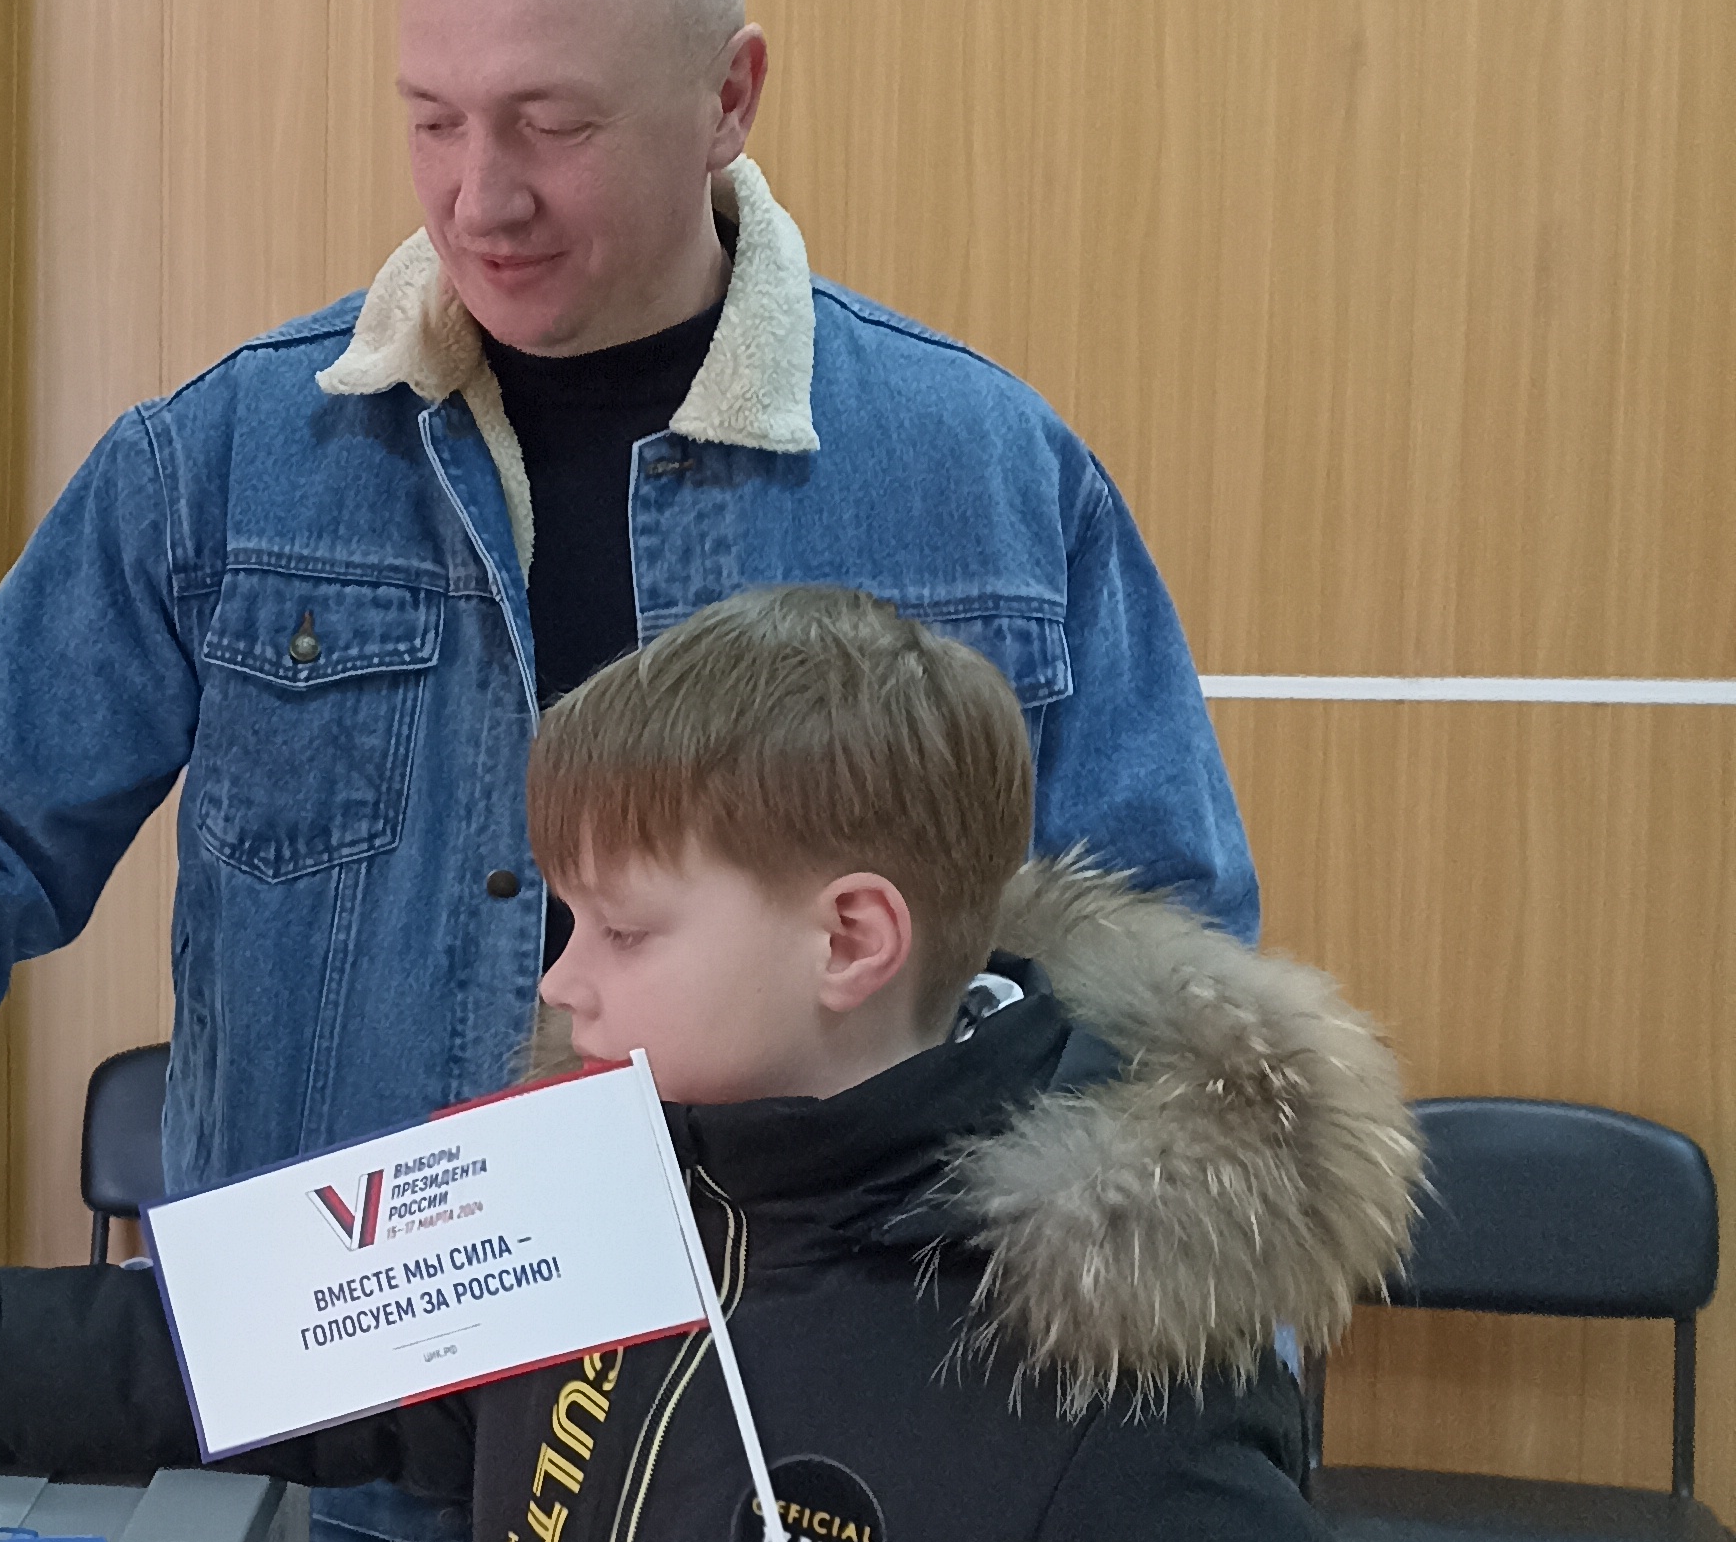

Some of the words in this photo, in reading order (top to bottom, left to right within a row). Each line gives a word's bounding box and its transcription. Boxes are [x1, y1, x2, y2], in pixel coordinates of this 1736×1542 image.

[391, 1158, 488, 1200] ПРЕЗИДЕНТА
[393, 1145, 461, 1179] ВЫБОРЫ
[388, 1190, 449, 1222] РОССИИ
[314, 1267, 400, 1312] ВМЕСТЕ
[402, 1254, 445, 1285] МЫ
[449, 1235, 513, 1270] СИЛА
[300, 1297, 417, 1350] ГОЛОСУЕМ
[419, 1288, 450, 1314] ЗА
[453, 1256, 562, 1305] РОССИЮ!
